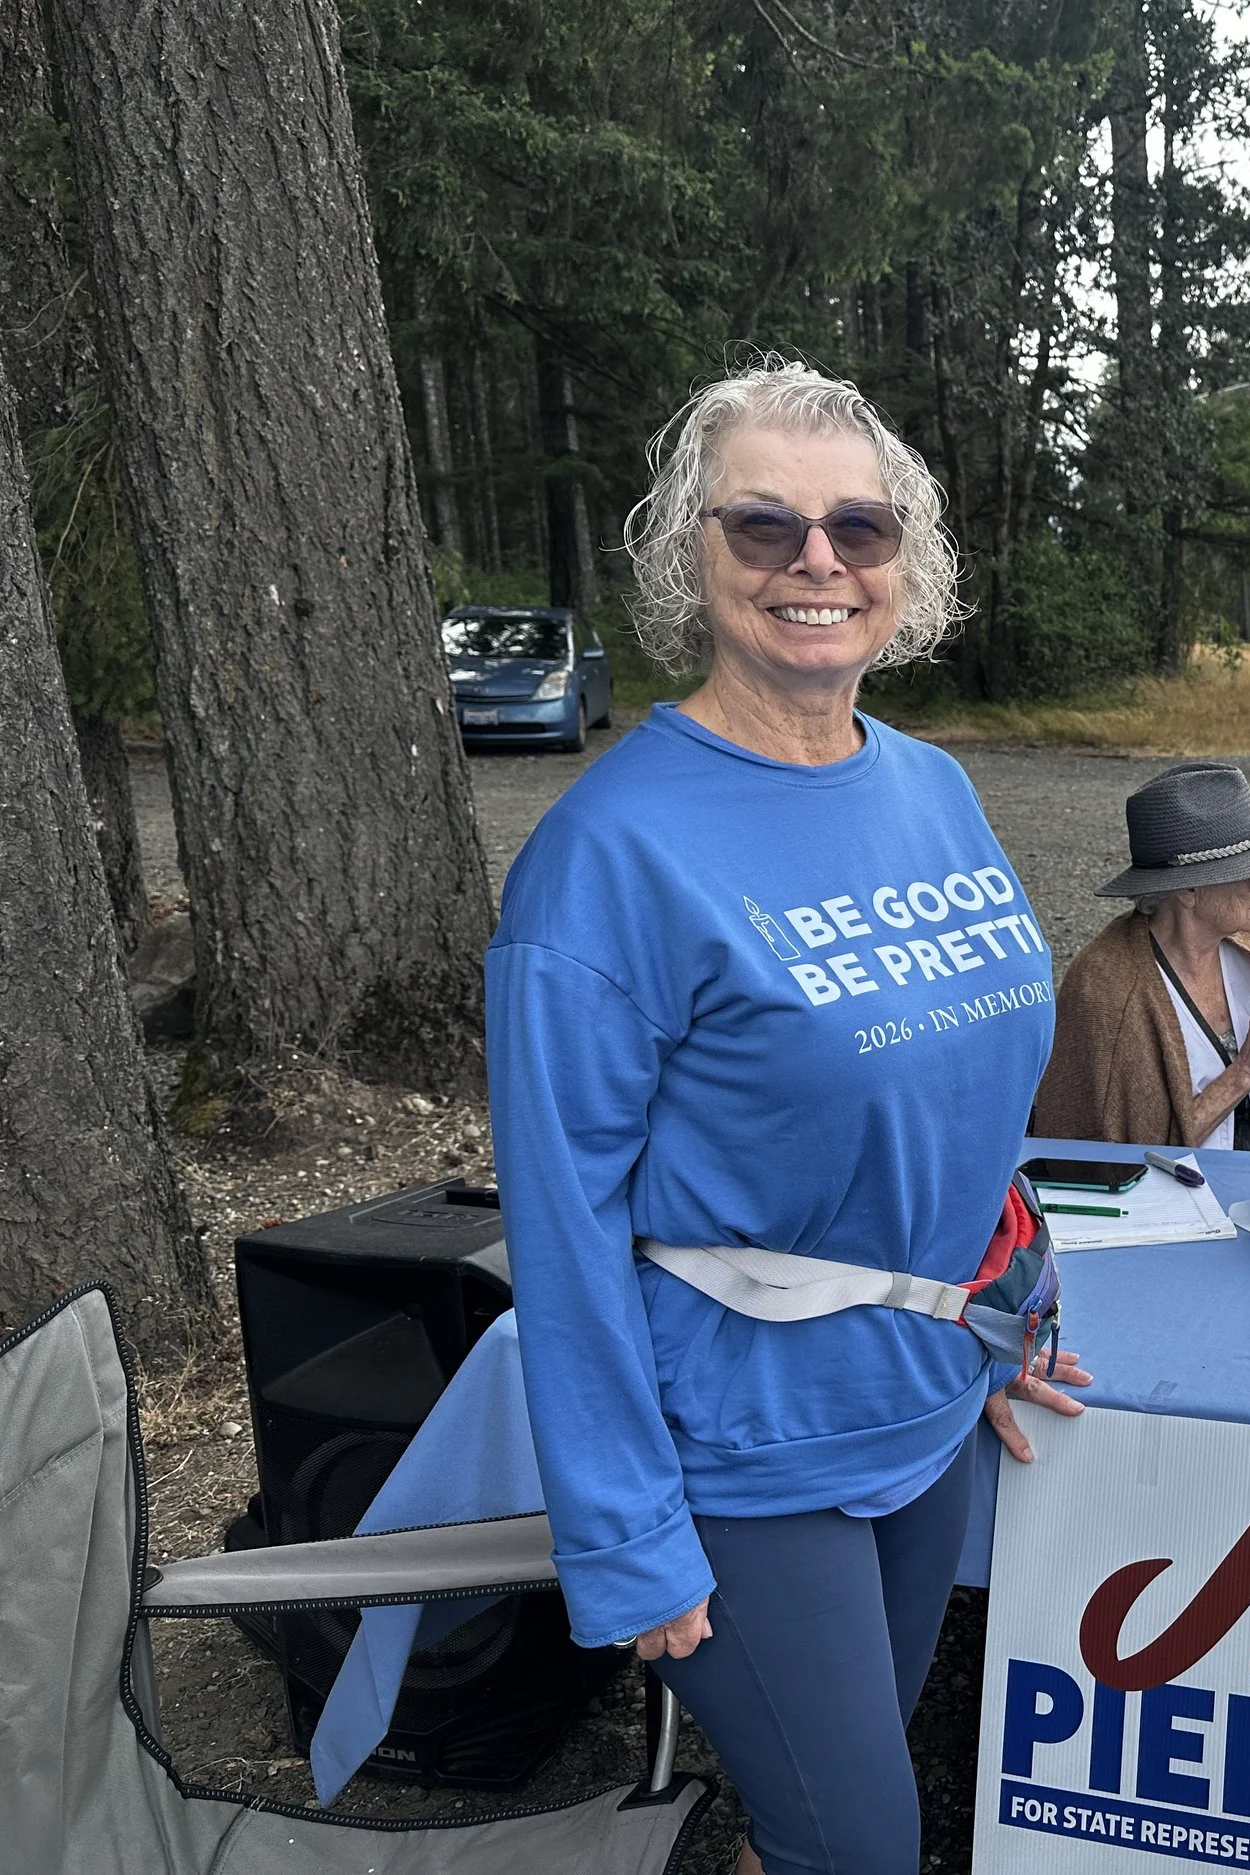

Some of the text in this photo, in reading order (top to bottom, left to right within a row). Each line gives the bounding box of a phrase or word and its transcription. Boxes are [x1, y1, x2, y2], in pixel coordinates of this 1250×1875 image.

[784, 866, 1015, 949] BE GOOD
[788, 914, 1044, 1007] BE PRETTI
[854, 980, 1052, 1054] 2026 IN MEMORY
[1011, 1796, 1058, 1826] FOR
[1063, 1806, 1135, 1840] STATE
